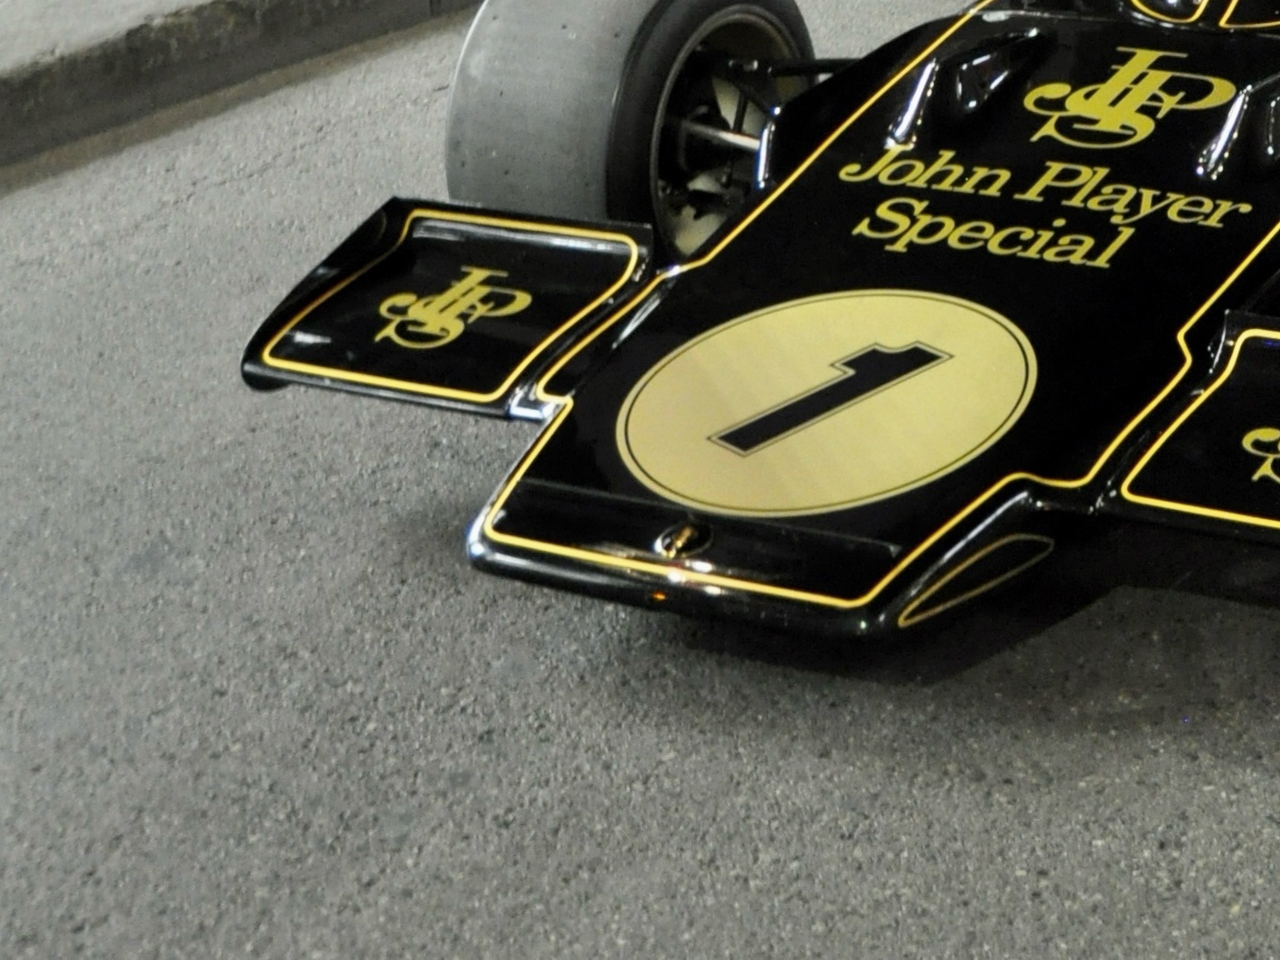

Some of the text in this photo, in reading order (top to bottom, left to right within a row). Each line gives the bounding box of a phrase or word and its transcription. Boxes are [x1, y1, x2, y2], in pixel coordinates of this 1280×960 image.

[1023, 46, 1237, 149] JPS
[838, 144, 1253, 228] John Player
[852, 196, 1136, 269] Special
[707, 341, 955, 458] 1
